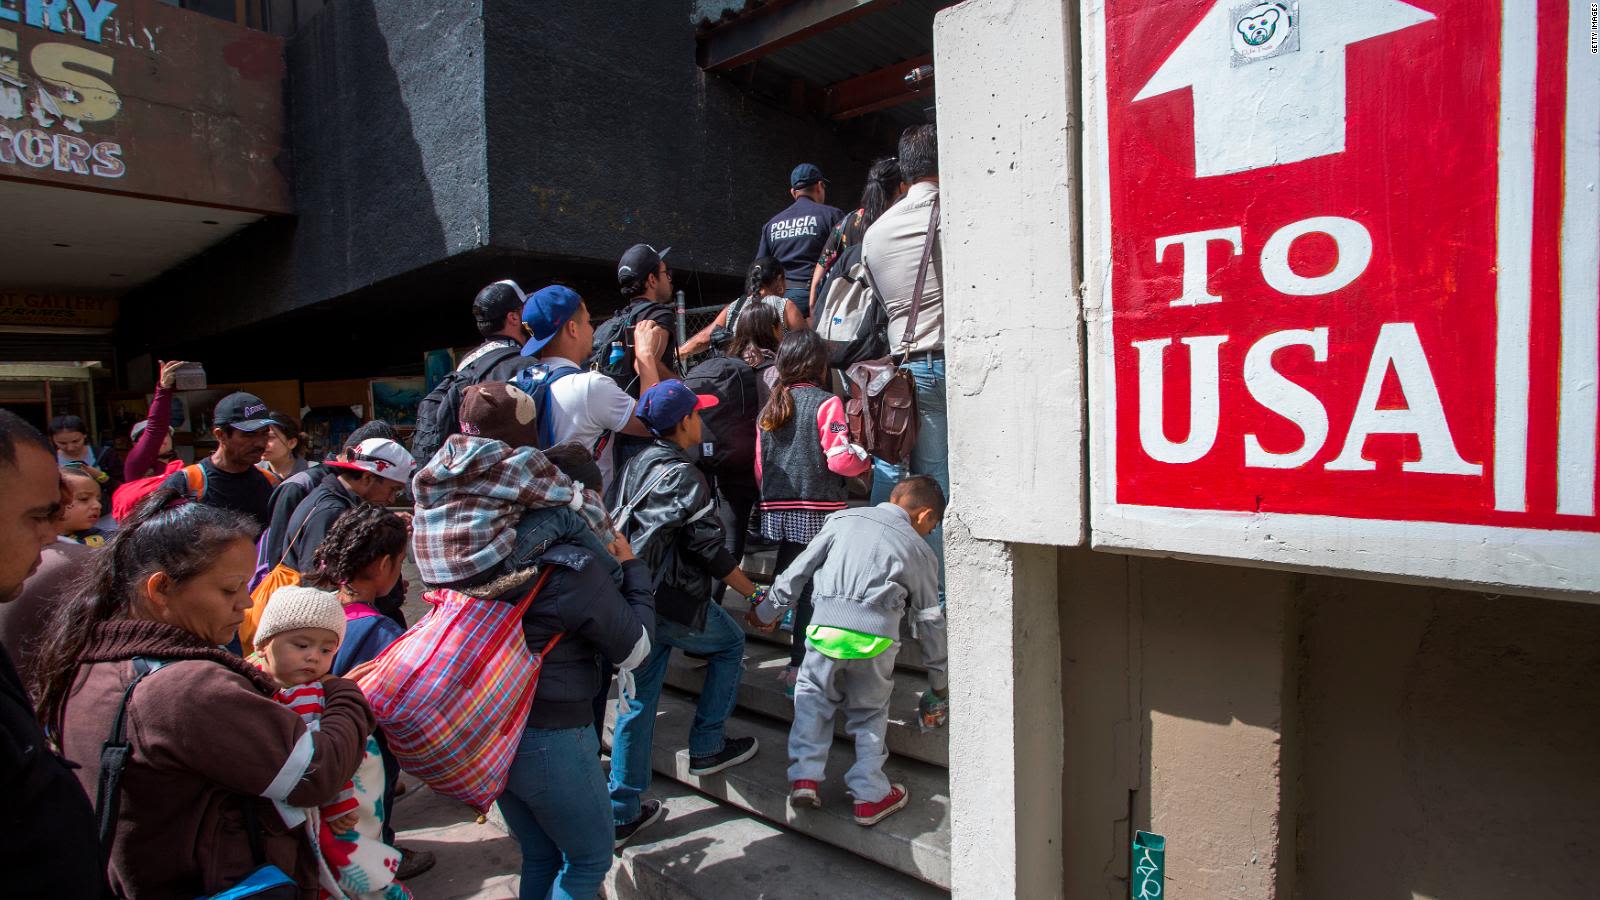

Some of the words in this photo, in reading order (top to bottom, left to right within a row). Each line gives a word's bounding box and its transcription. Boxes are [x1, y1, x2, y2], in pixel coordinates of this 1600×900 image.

[771, 215, 817, 232] POLICÍA
[771, 226, 817, 242] FEDERAL
[1155, 216, 1373, 307] TO
[24, 294, 108, 311] GALLERY
[1131, 322, 1483, 476] USA
